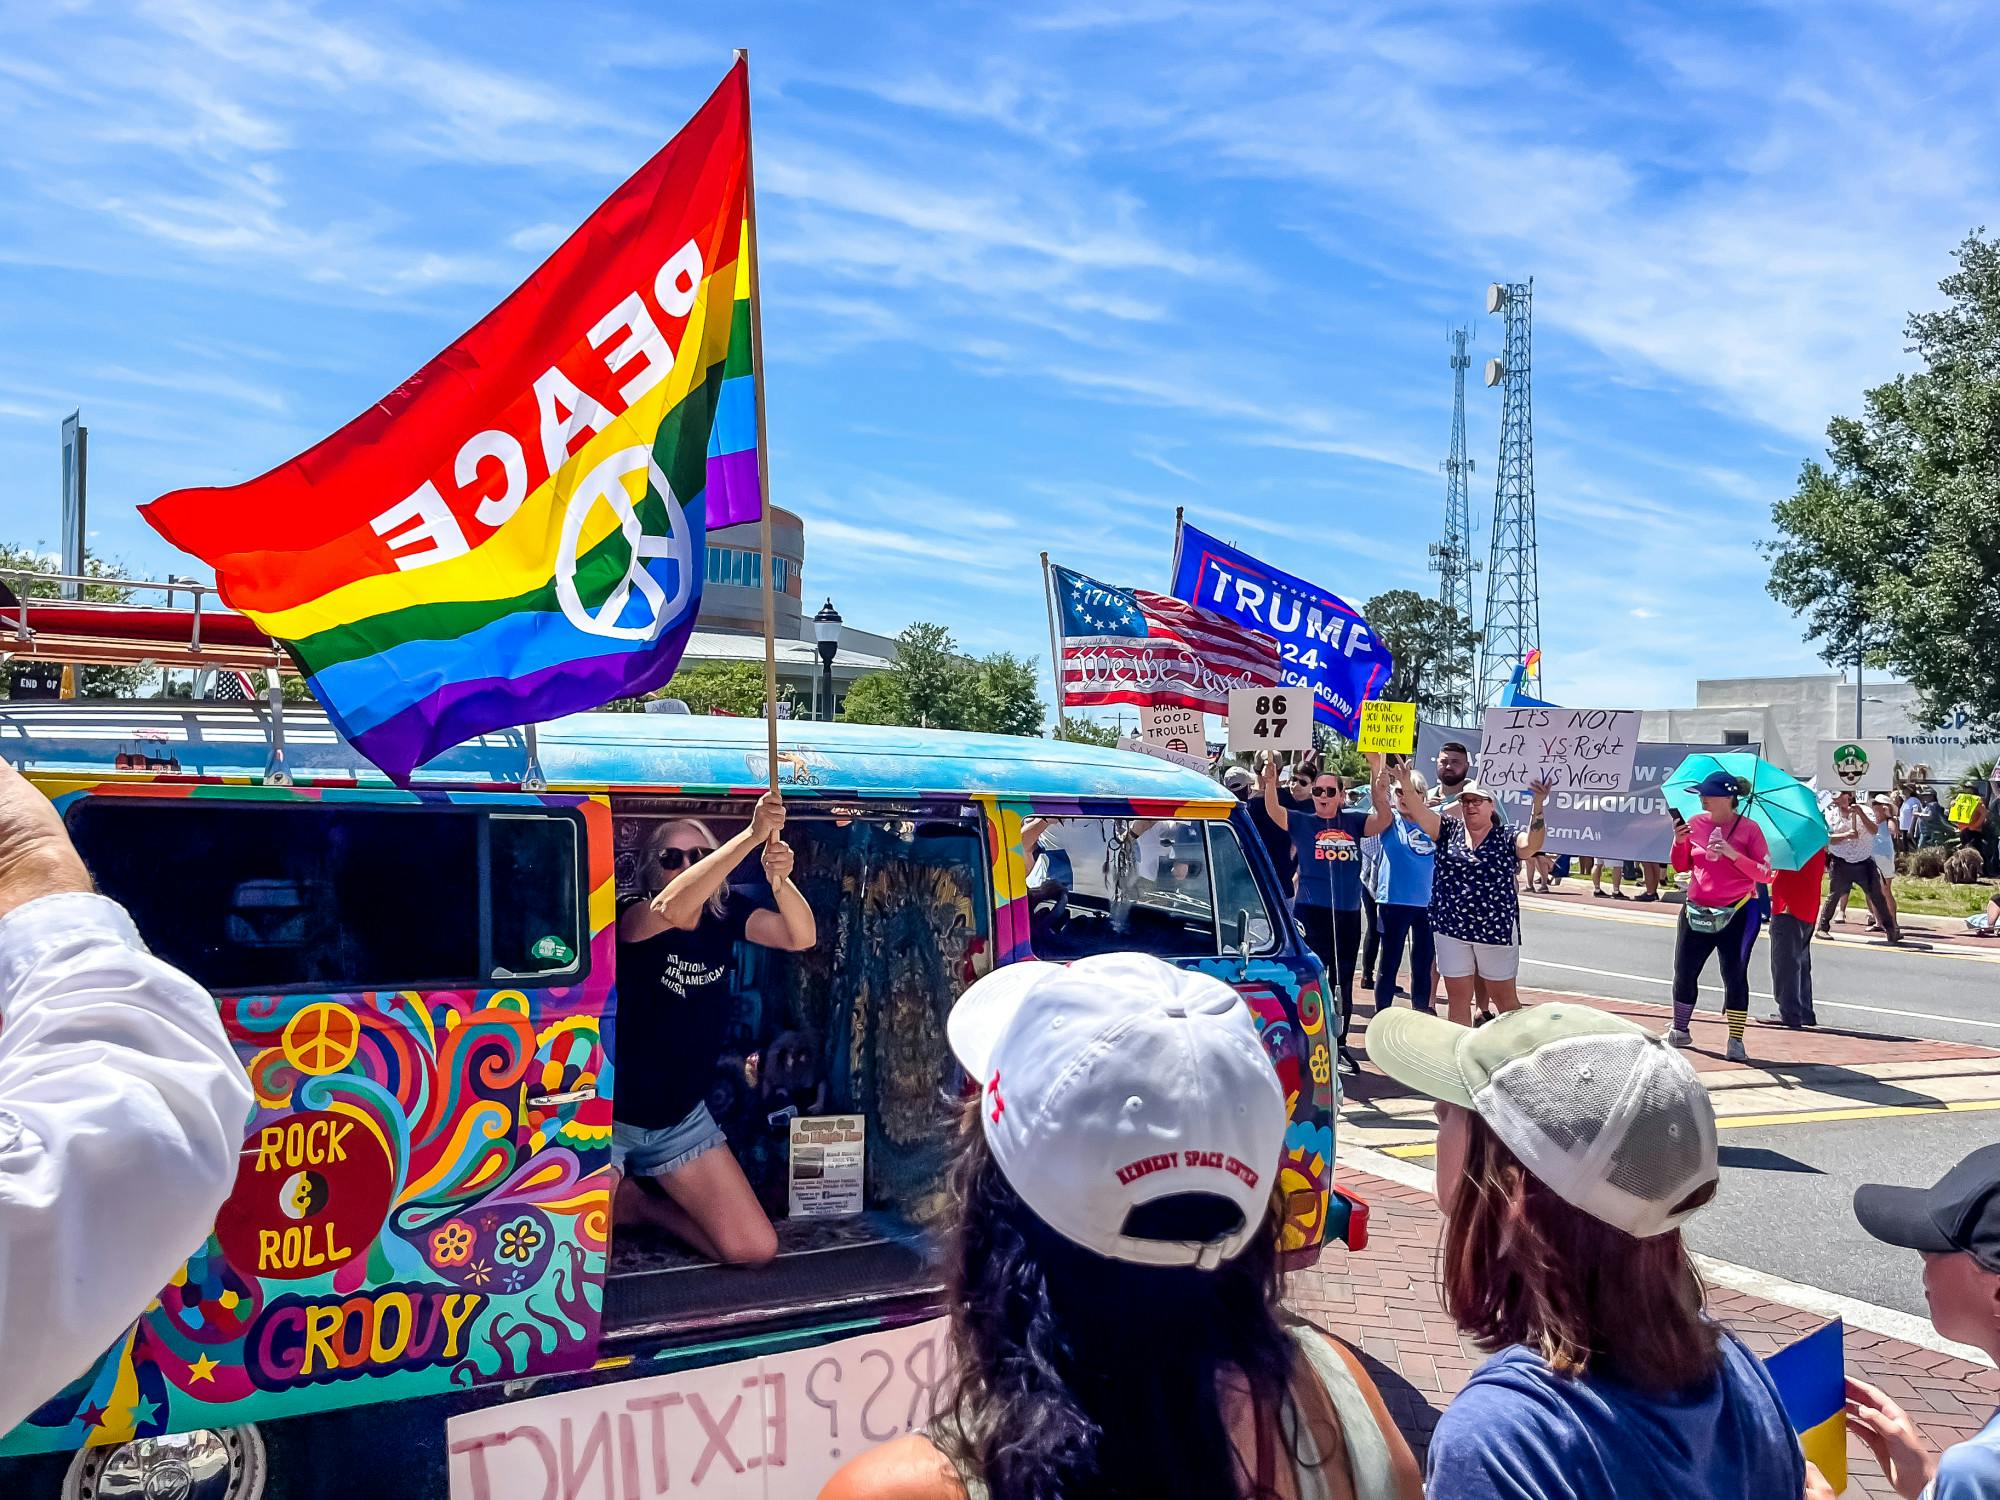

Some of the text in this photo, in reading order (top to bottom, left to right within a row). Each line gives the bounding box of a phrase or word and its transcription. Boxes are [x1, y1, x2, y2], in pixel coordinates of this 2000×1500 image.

[1084, 589, 1123, 607] 1776
[1211, 561, 1373, 658] TRUMP
[1073, 646, 1134, 688] We
[1133, 648, 1179, 692] the
[20, 678, 58, 690] END OF
[1256, 695, 1288, 715] 86
[1313, 681, 1353, 719] AGAIN!
[1364, 702, 1393, 713] SOMEONE
[1154, 713, 1191, 724] GOOD
[1253, 718, 1288, 739] 47
[1367, 723, 1381, 733] MAY
[1381, 713, 1403, 723] KNOW
[1568, 710, 1634, 731] NOT
[1147, 723, 1200, 738] TROUBLE
[1130, 743, 1152, 756] SAY
[1484, 734, 1525, 756] Left
[1574, 735, 1624, 760] Right
[1480, 758, 1529, 786] Right
[1565, 763, 1621, 790] Wrong
[1315, 849, 1359, 861] BOOK
[255, 1119, 354, 1173] ROCK
[1115, 1152, 1179, 1186] KENNEDY
[1184, 1150, 1225, 1169] SPACE
[290, 1172, 313, 1219] &
[258, 1222, 352, 1271] ROLL
[257, 1291, 482, 1381] GROOVY
